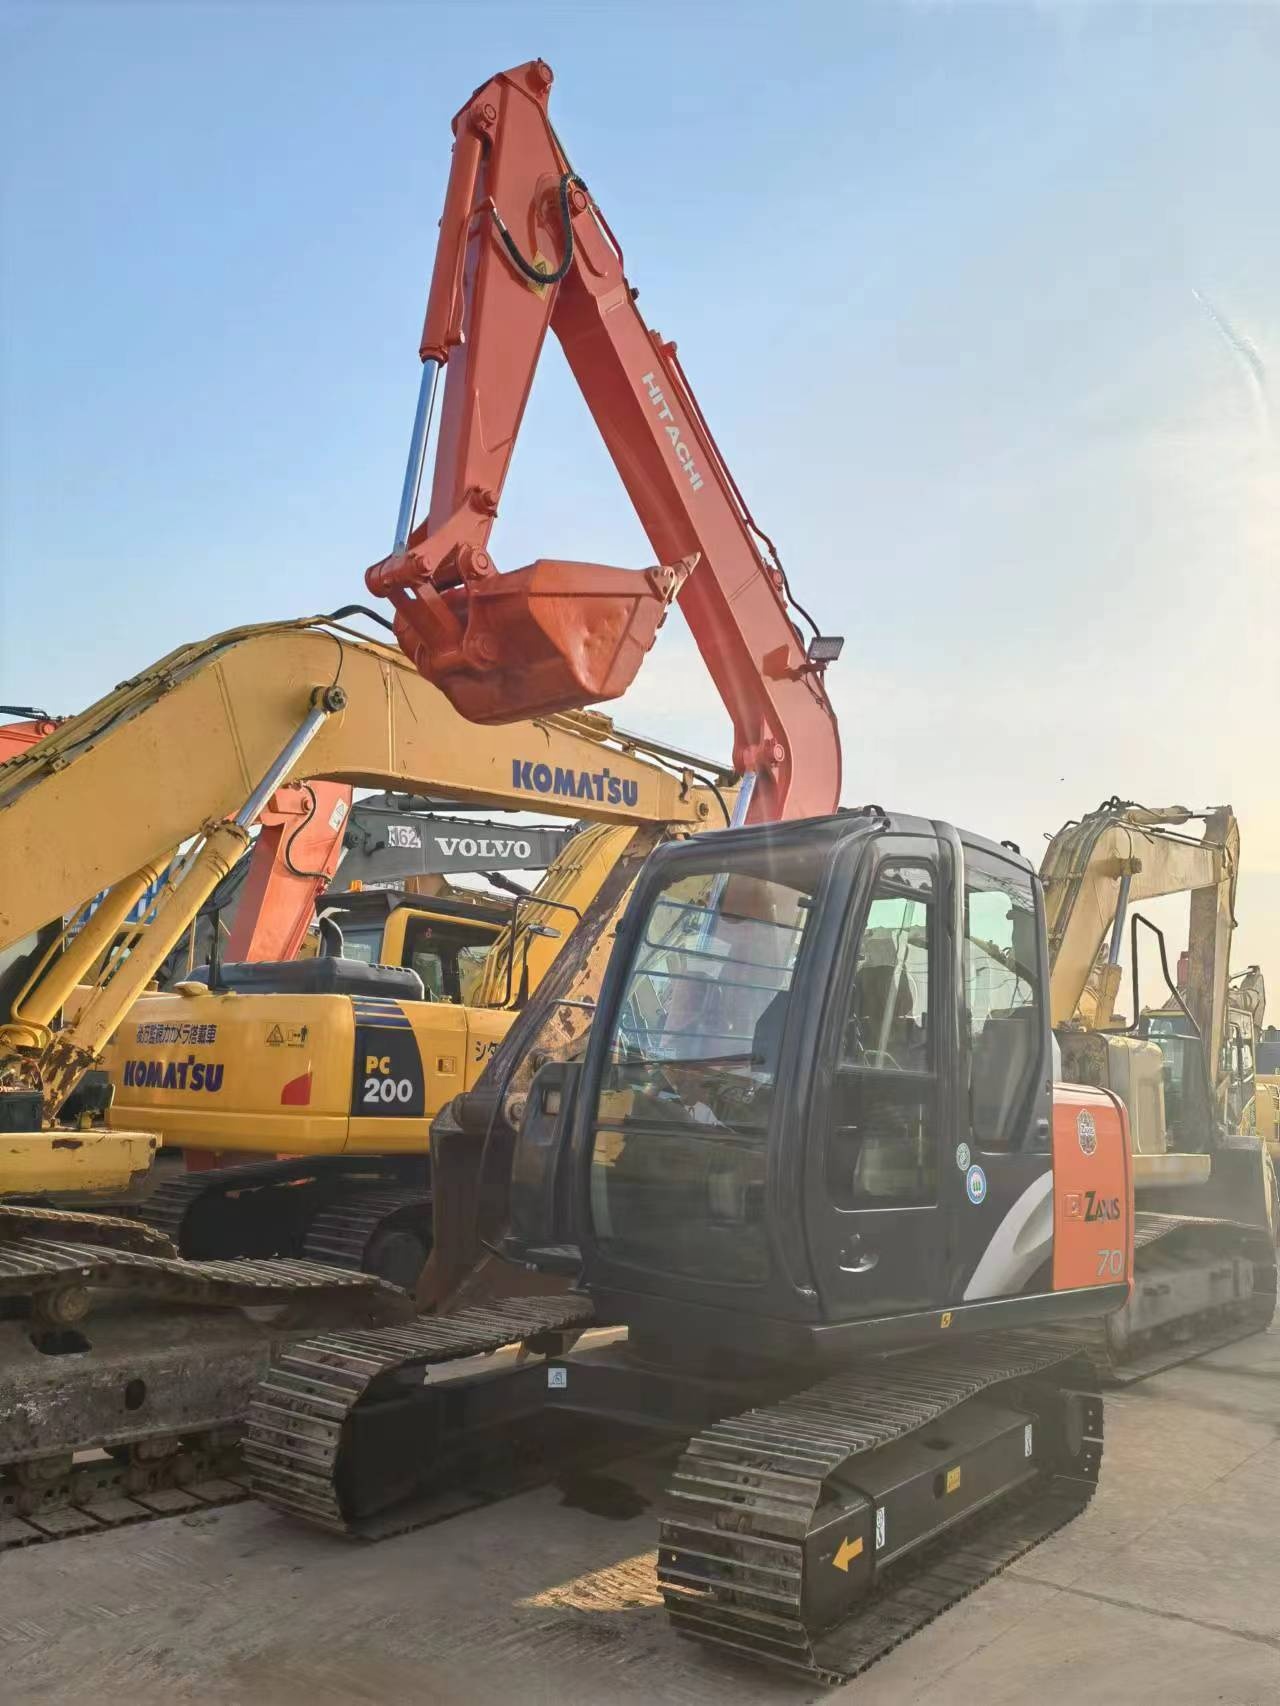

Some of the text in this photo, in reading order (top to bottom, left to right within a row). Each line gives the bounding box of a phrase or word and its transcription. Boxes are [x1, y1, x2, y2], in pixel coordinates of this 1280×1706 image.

[641, 371, 704, 491] HITACHI
[512, 759, 638, 807] KOMATSU
[434, 837, 531, 858] VOLVO
[124, 1055, 224, 1092] KOMATSU
[366, 1056, 391, 1075] PC
[363, 1078, 413, 1103] 200
[1097, 1249, 1123, 1277] 70
